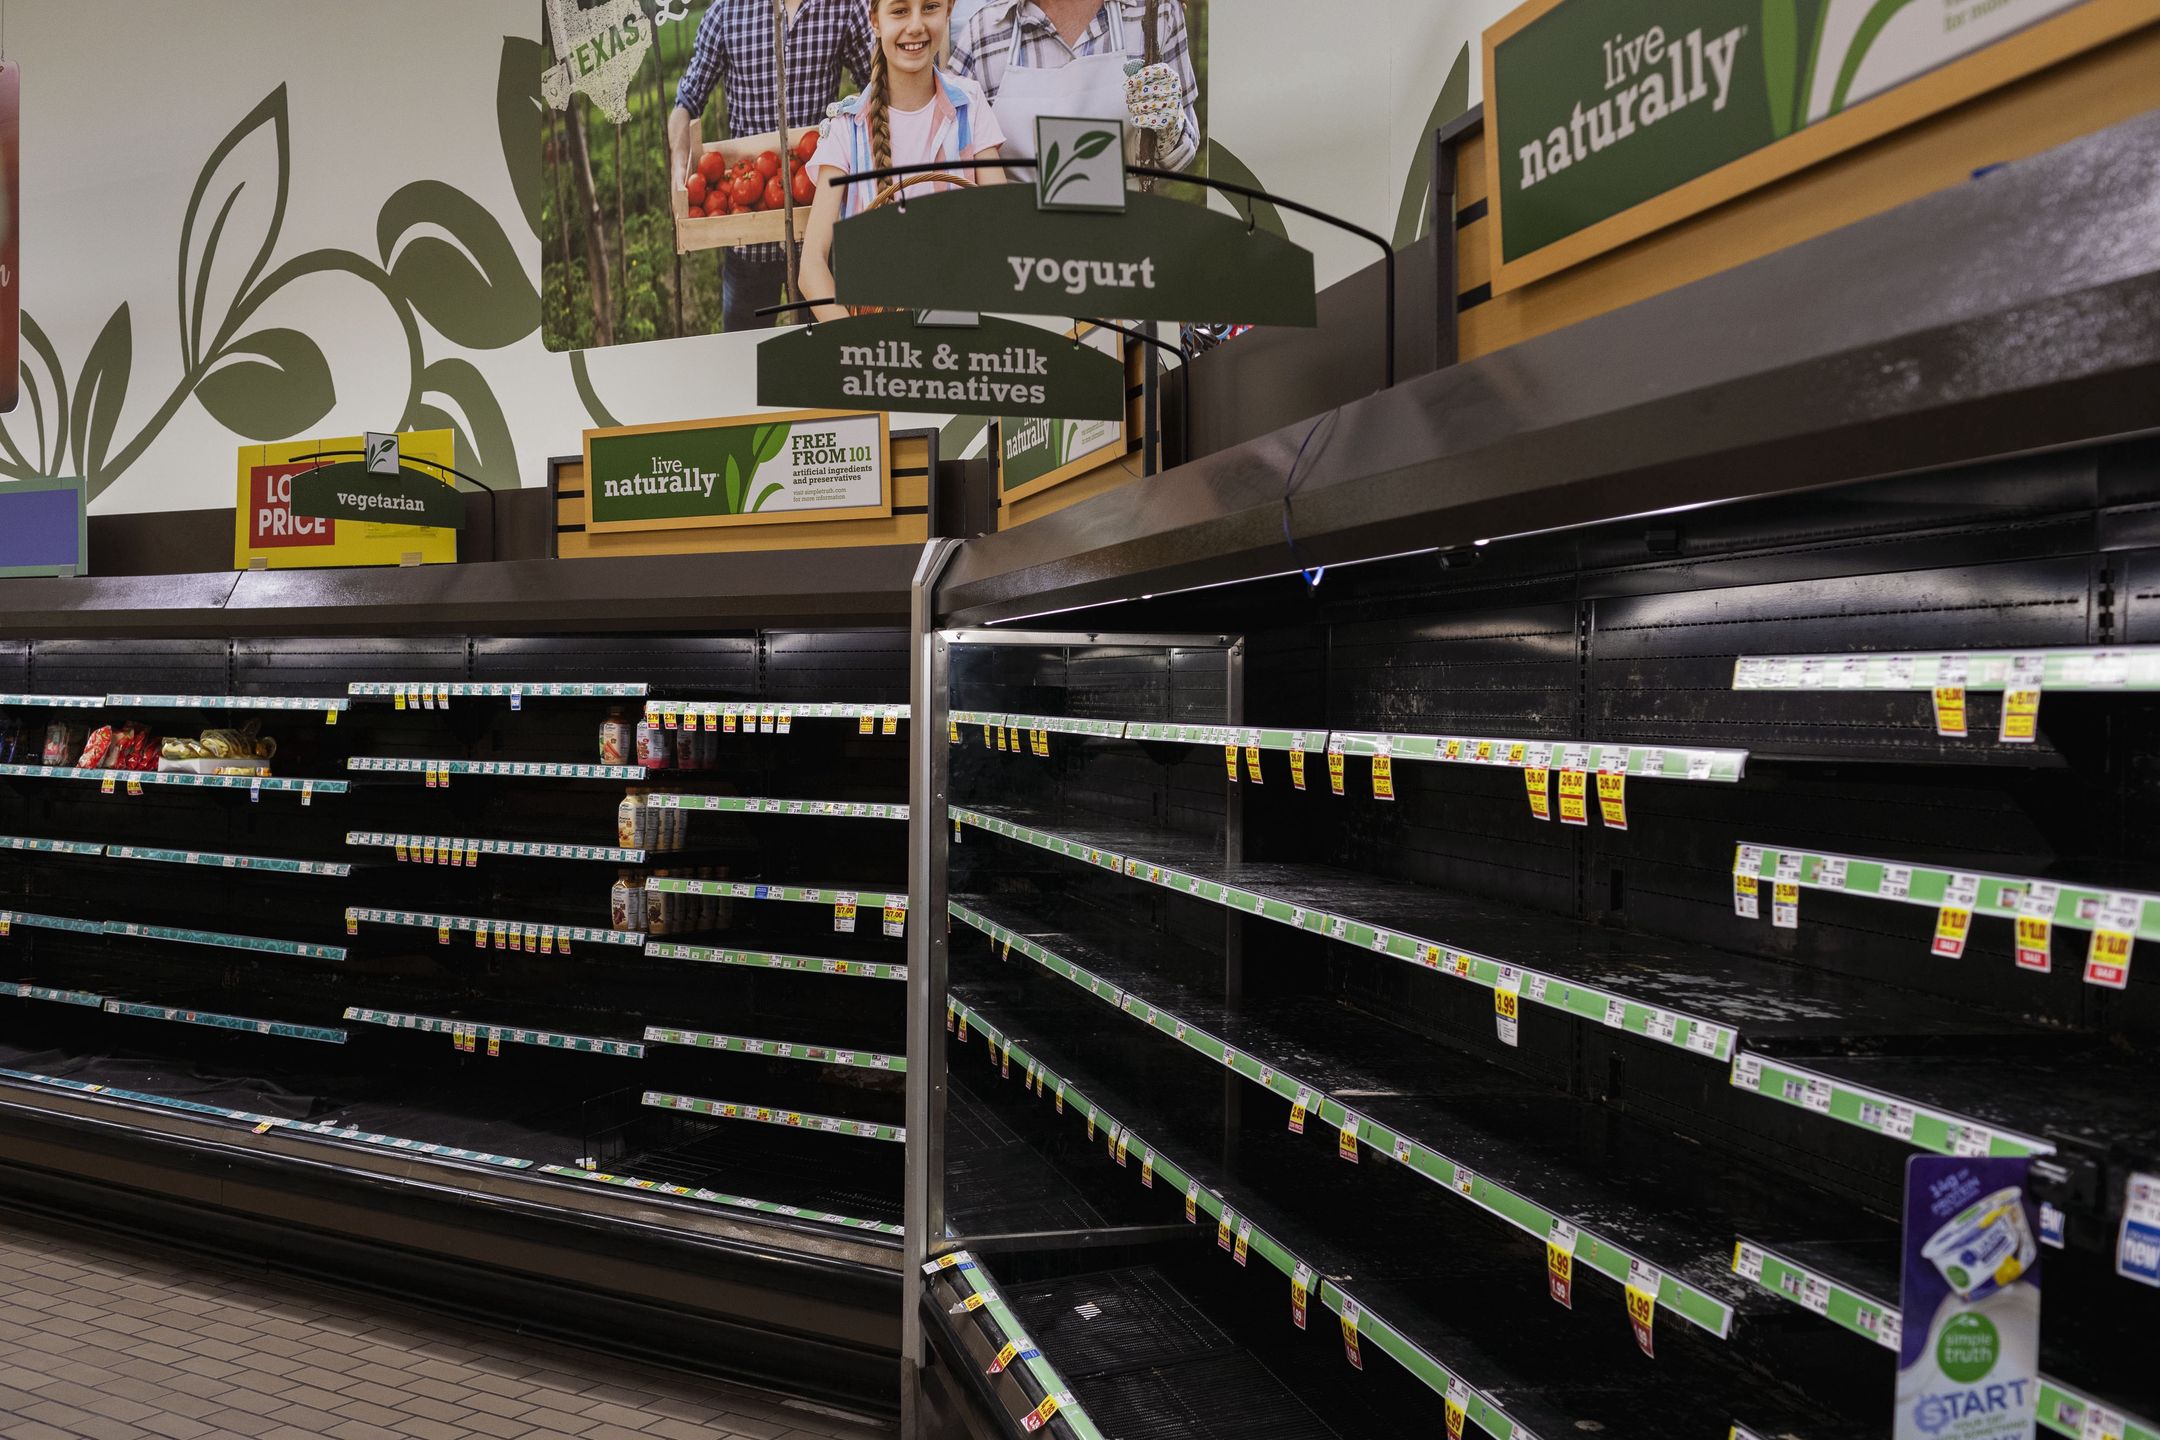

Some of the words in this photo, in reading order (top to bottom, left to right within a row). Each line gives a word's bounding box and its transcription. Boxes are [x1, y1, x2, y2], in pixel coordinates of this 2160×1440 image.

[559, 13, 640, 85] TEXAS
[1603, 25, 1665, 90] live
[1519, 26, 1742, 190] naturally
[1007, 256, 1155, 294] yogurt
[840, 341, 922, 369] milk
[932, 344, 958, 370] &
[968, 348, 1048, 375] milk
[842, 370, 1046, 404] alternatives
[792, 432, 837, 450] FREE
[1006, 418, 1050, 460] naturally
[652, 457, 682, 475] live
[792, 448, 847, 466] FROM
[849, 446, 872, 462] 101
[604, 467, 718, 497] naturally
[792, 467, 827, 477] artificial
[828, 465, 873, 476] ingredients
[792, 477, 807, 485] and
[809, 474, 862, 486] preservatives
[267, 474, 292, 503] LO
[337, 491, 425, 512] vegetarian
[258, 508, 326, 537] PRICE
[1496, 993, 1515, 1016] 3.99
[1292, 1106, 1304, 1120] 2.99
[1341, 1132, 1355, 1149] 2.99
[1550, 1248, 1569, 1275] 2.99
[1292, 1284, 1305, 1304] 2.99
[1552, 1278, 1566, 1299] 1.99
[1628, 1292, 1650, 1322] 2.99
[1343, 1322, 1357, 1344] 2.99
[1945, 1332, 1993, 1349] simple
[1945, 1346, 1993, 1363] truth
[1914, 1378, 2029, 1433] START
[1446, 1405, 1461, 1431] 2.99
